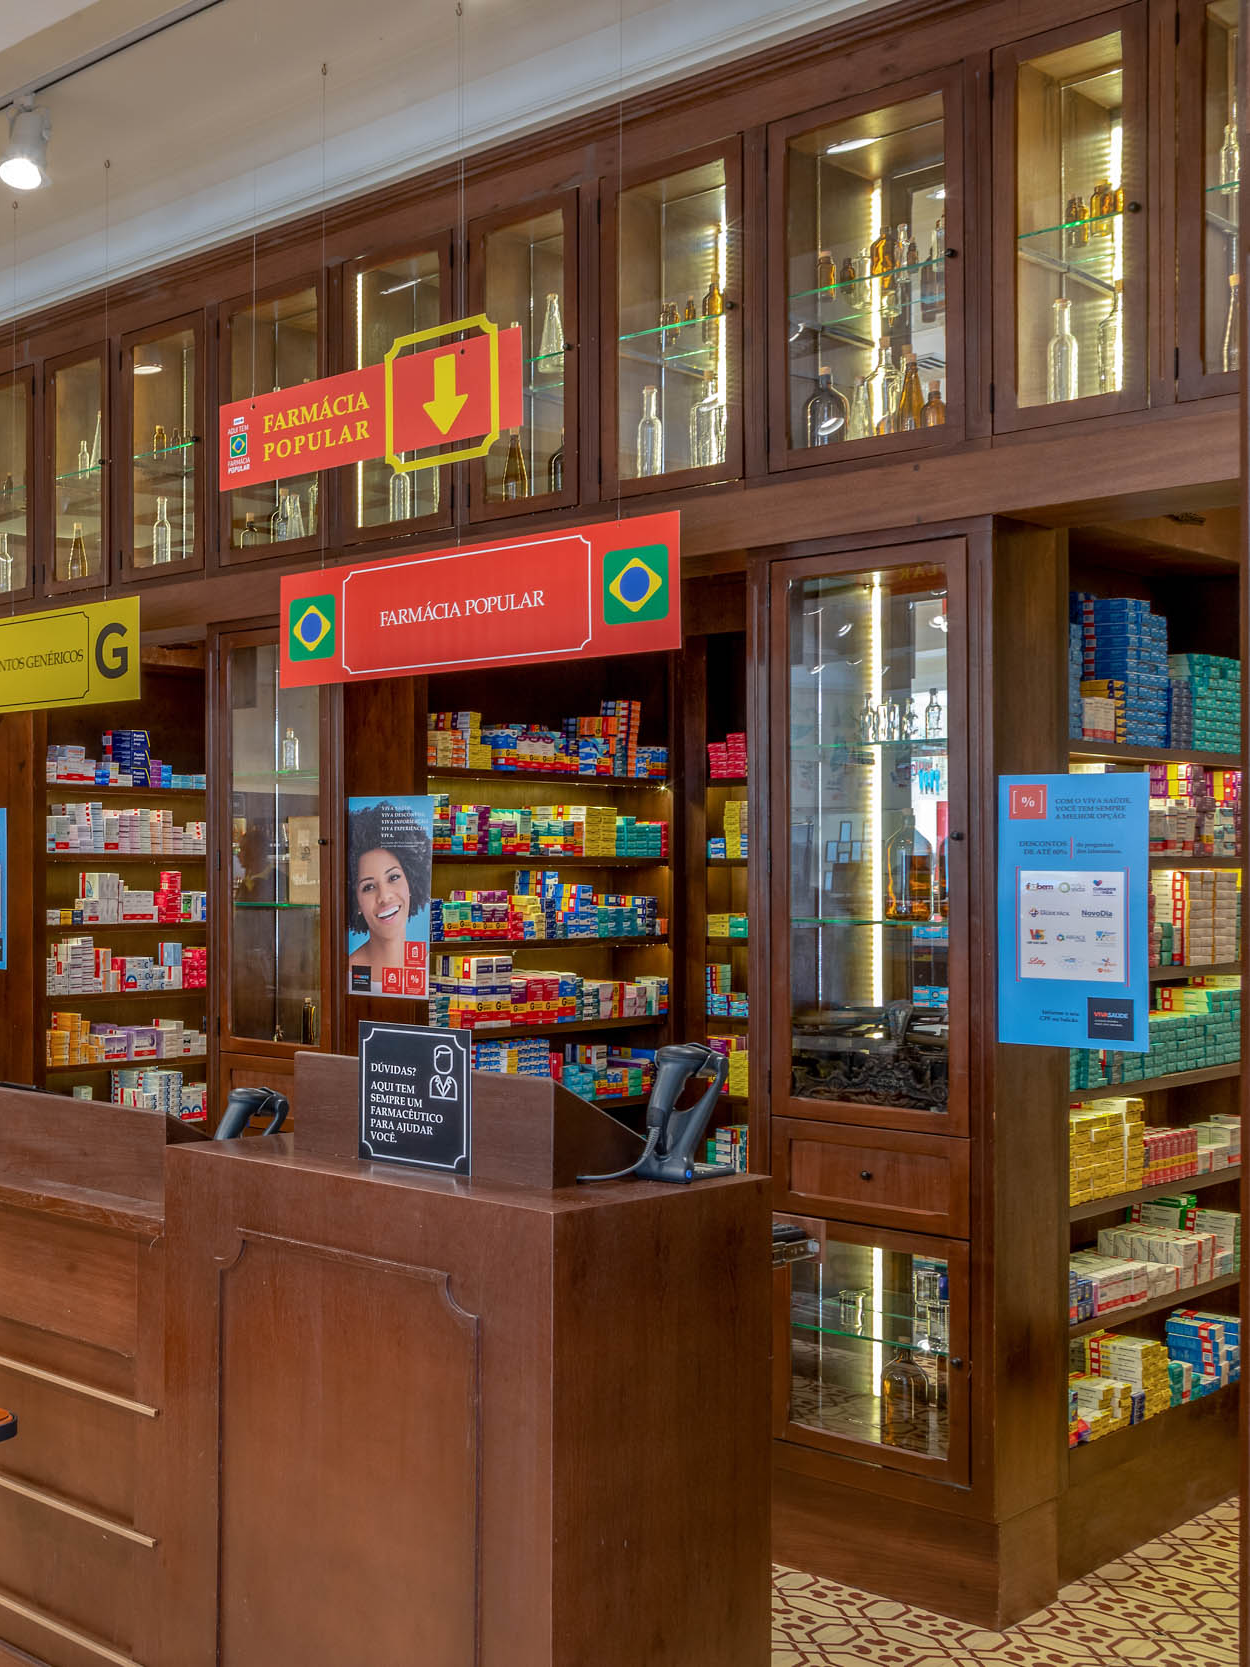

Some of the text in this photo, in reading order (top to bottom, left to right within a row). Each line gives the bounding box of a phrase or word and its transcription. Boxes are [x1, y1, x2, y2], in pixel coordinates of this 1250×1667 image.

[262, 391, 370, 434] FARMÁCIA
[262, 420, 370, 462] POPULAR
[379, 589, 545, 628] FARMÁCIA POPULAR
[26, 649, 84, 669] GENÉRICOS
[95, 622, 129, 679] G
[370, 1062, 417, 1077] DÚVIDAS?
[370, 1081, 415, 1094] AQUI TEM
[370, 1093, 423, 1108] SEMPRE UM
[370, 1105, 444, 1124] FARMACÊUTICO
[370, 1118, 434, 1136] PARA AJUDAR
[370, 1130, 398, 1144] VOCÊ.
